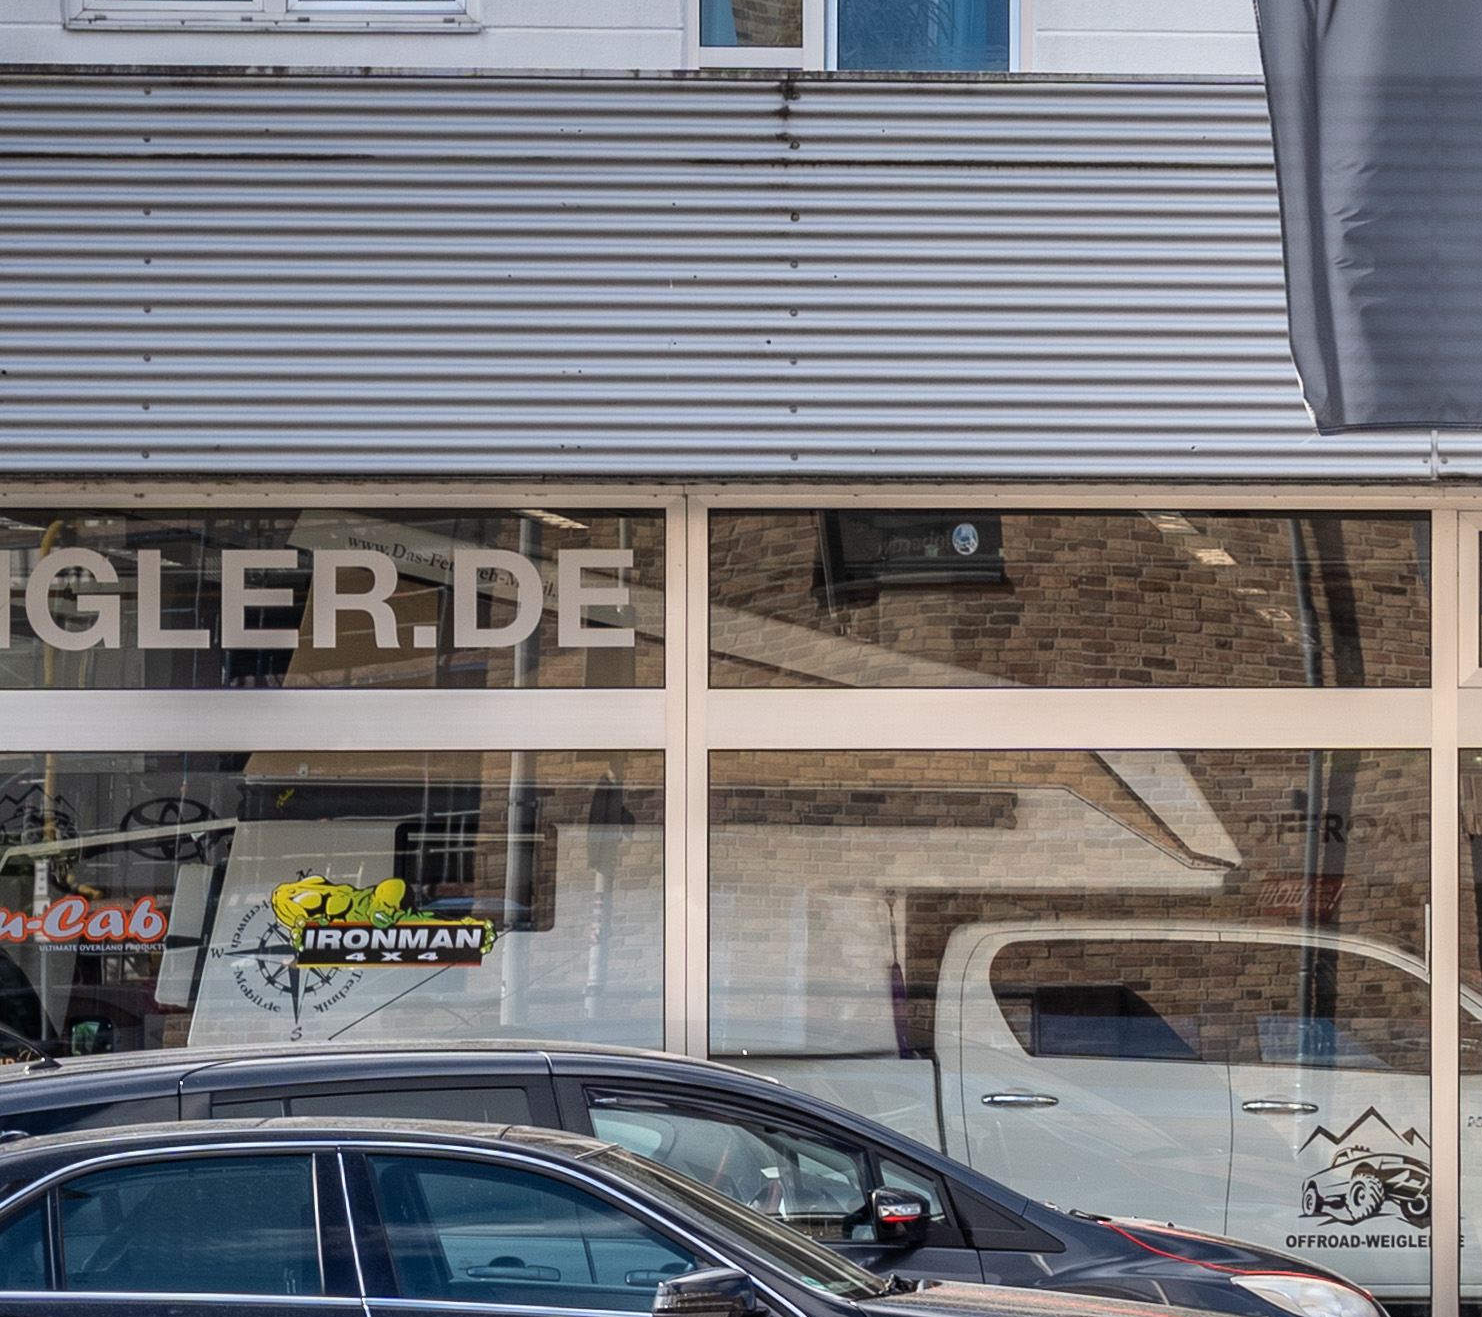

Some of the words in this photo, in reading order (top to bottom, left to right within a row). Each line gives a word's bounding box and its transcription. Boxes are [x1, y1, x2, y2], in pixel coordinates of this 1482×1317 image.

[303, 928, 483, 950] IRONMAN
[39, 944, 78, 952] ULTIMATE
[79, 944, 124, 952] OVERLAND
[125, 943, 167, 951] PRODUCTS
[345, 951, 367, 962] 4
[417, 951, 439, 962] 4
[1286, 1234, 1465, 1248] OFFROAD-WEIGLEE
